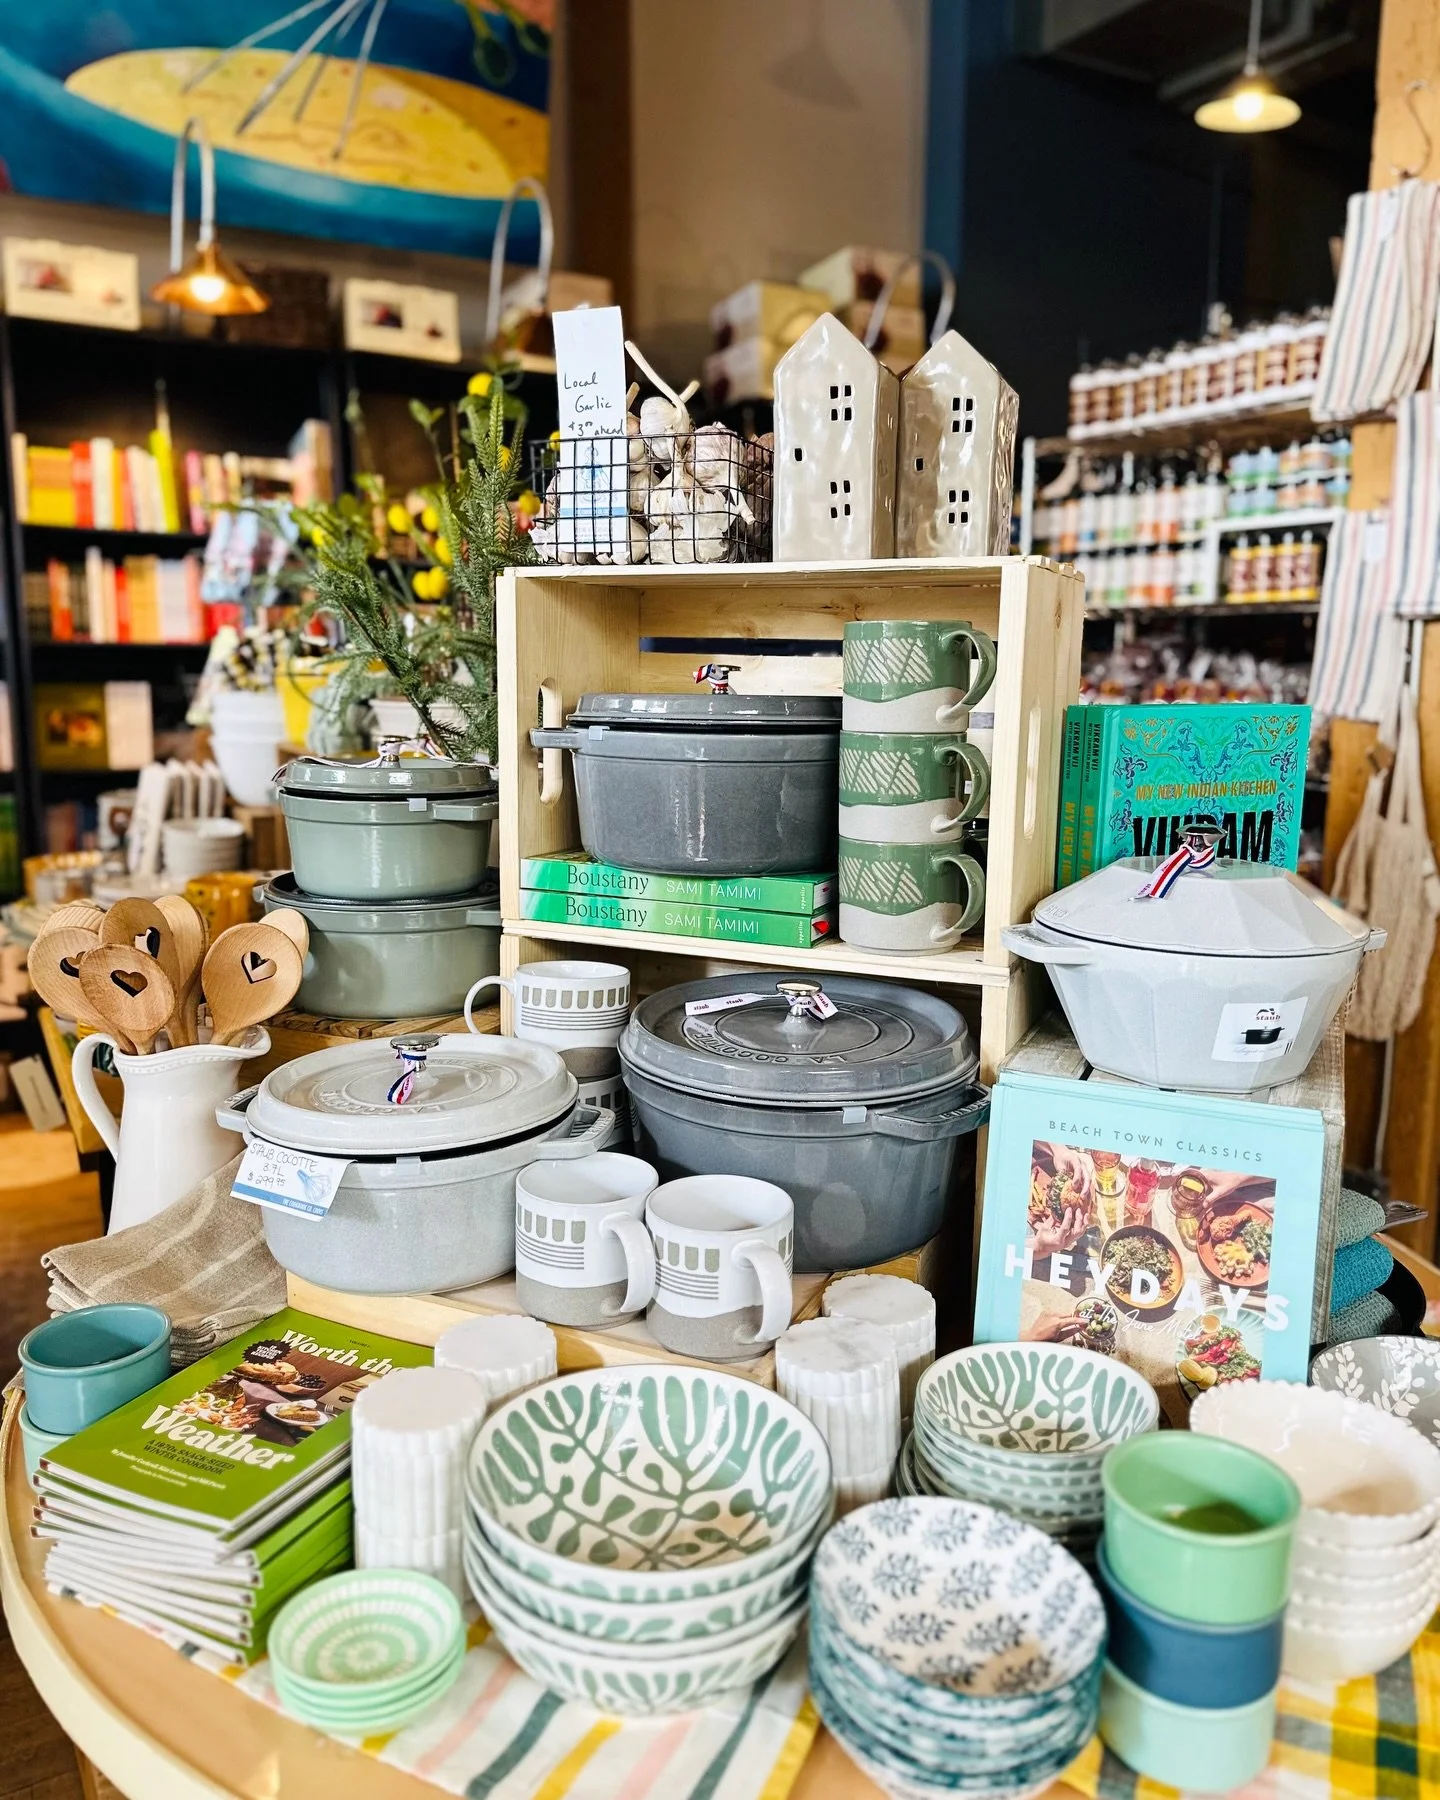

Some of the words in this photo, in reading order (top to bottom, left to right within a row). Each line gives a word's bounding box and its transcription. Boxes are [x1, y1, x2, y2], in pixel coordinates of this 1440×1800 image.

[564, 371, 598, 389] Local
[575, 394, 612, 413] Garlic
[1072, 720, 1080, 754] VIKRAM
[1091, 723, 1101, 756] VIKRAM
[1091, 758, 1099, 771] VIJ
[1135, 785, 1154, 801] MY
[1158, 783, 1184, 800] NEW
[1186, 781, 1228, 799] INDIAN
[1065, 802, 1075, 823] MY
[1063, 826, 1074, 856] NEW
[567, 864, 649, 894] Boustany
[666, 880, 703, 896] SAMI
[708, 883, 762, 901] TAMIMI
[565, 897, 648, 928] Boustany
[664, 913, 701, 929] SAMI
[706, 916, 760, 935] TAMIMI
[1049, 1120, 1102, 1138] BEACH
[1114, 1130, 1164, 1147] TOWN
[1176, 1141, 1263, 1162] CLASSICS
[250, 1142, 275, 1161] STAUB
[276, 1150, 318, 1174] COCOTTE
[1004, 1243, 1291, 1332] HEYDAYS
[1079, 1308, 1093, 1320] at
[1098, 1304, 1119, 1324] The
[1122, 1308, 1155, 1332] June
[281, 1329, 359, 1366] Worth
[359, 1357, 403, 1376] th
[141, 1404, 295, 1470] Weather
[143, 1444, 178, 1461] WINTER
[177, 1456, 224, 1475] COOKBOOK
[178, 1449, 236, 1470] SNACK-SIZED
